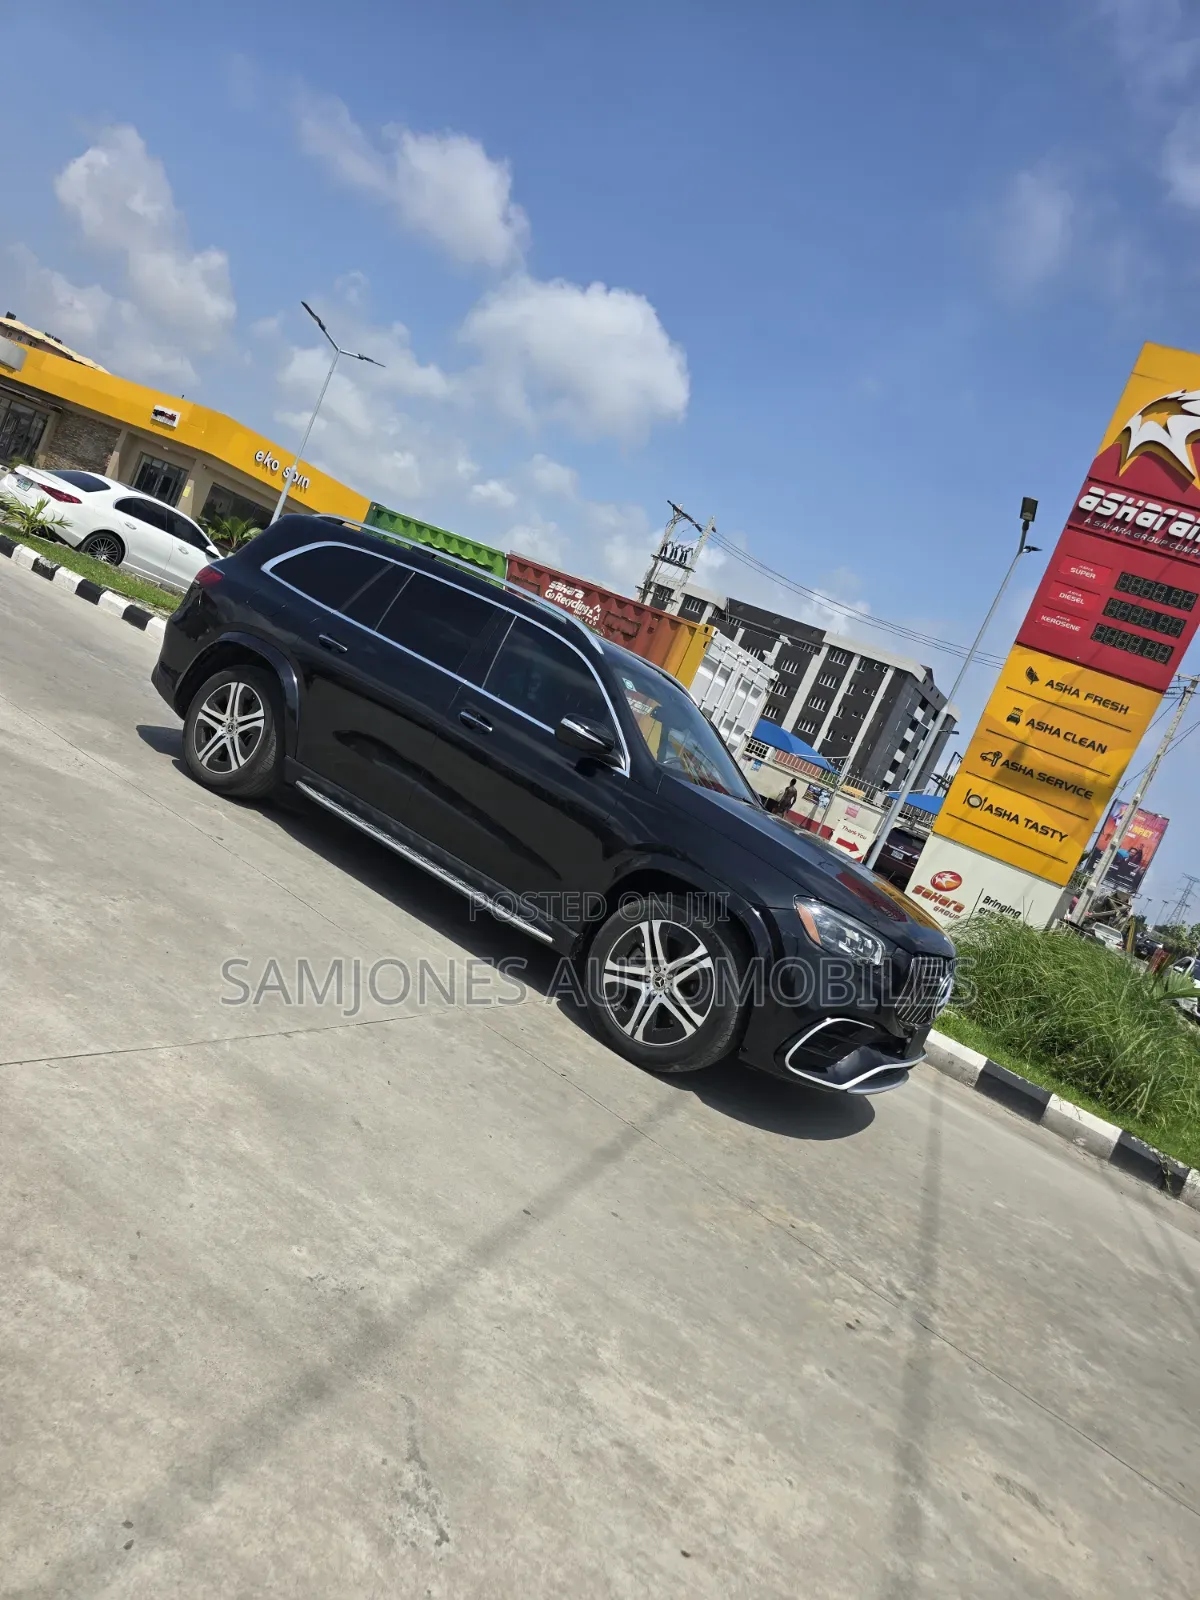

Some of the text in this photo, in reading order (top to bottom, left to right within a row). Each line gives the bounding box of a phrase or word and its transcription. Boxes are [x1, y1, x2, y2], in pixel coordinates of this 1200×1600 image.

[254, 450, 280, 471] eko
[1093, 520, 1132, 535] SAHARA
[1133, 532, 1168, 545] GROUP
[1070, 567, 1097, 579] SUPER
[554, 592, 591, 615] Recycling
[1058, 592, 1084, 605] DIESEL
[1041, 615, 1081, 632] KEROSENE
[1044, 679, 1130, 716] ASHA FRESH
[1025, 718, 1108, 754] ASHA CLEAN
[1000, 758, 1094, 800] ASHA SERVICE
[842, 825, 867, 840] Thank You
[983, 803, 1069, 843] ASHA TASTY
[933, 905, 961, 920] GROUP
[982, 895, 1022, 919] Bringing
